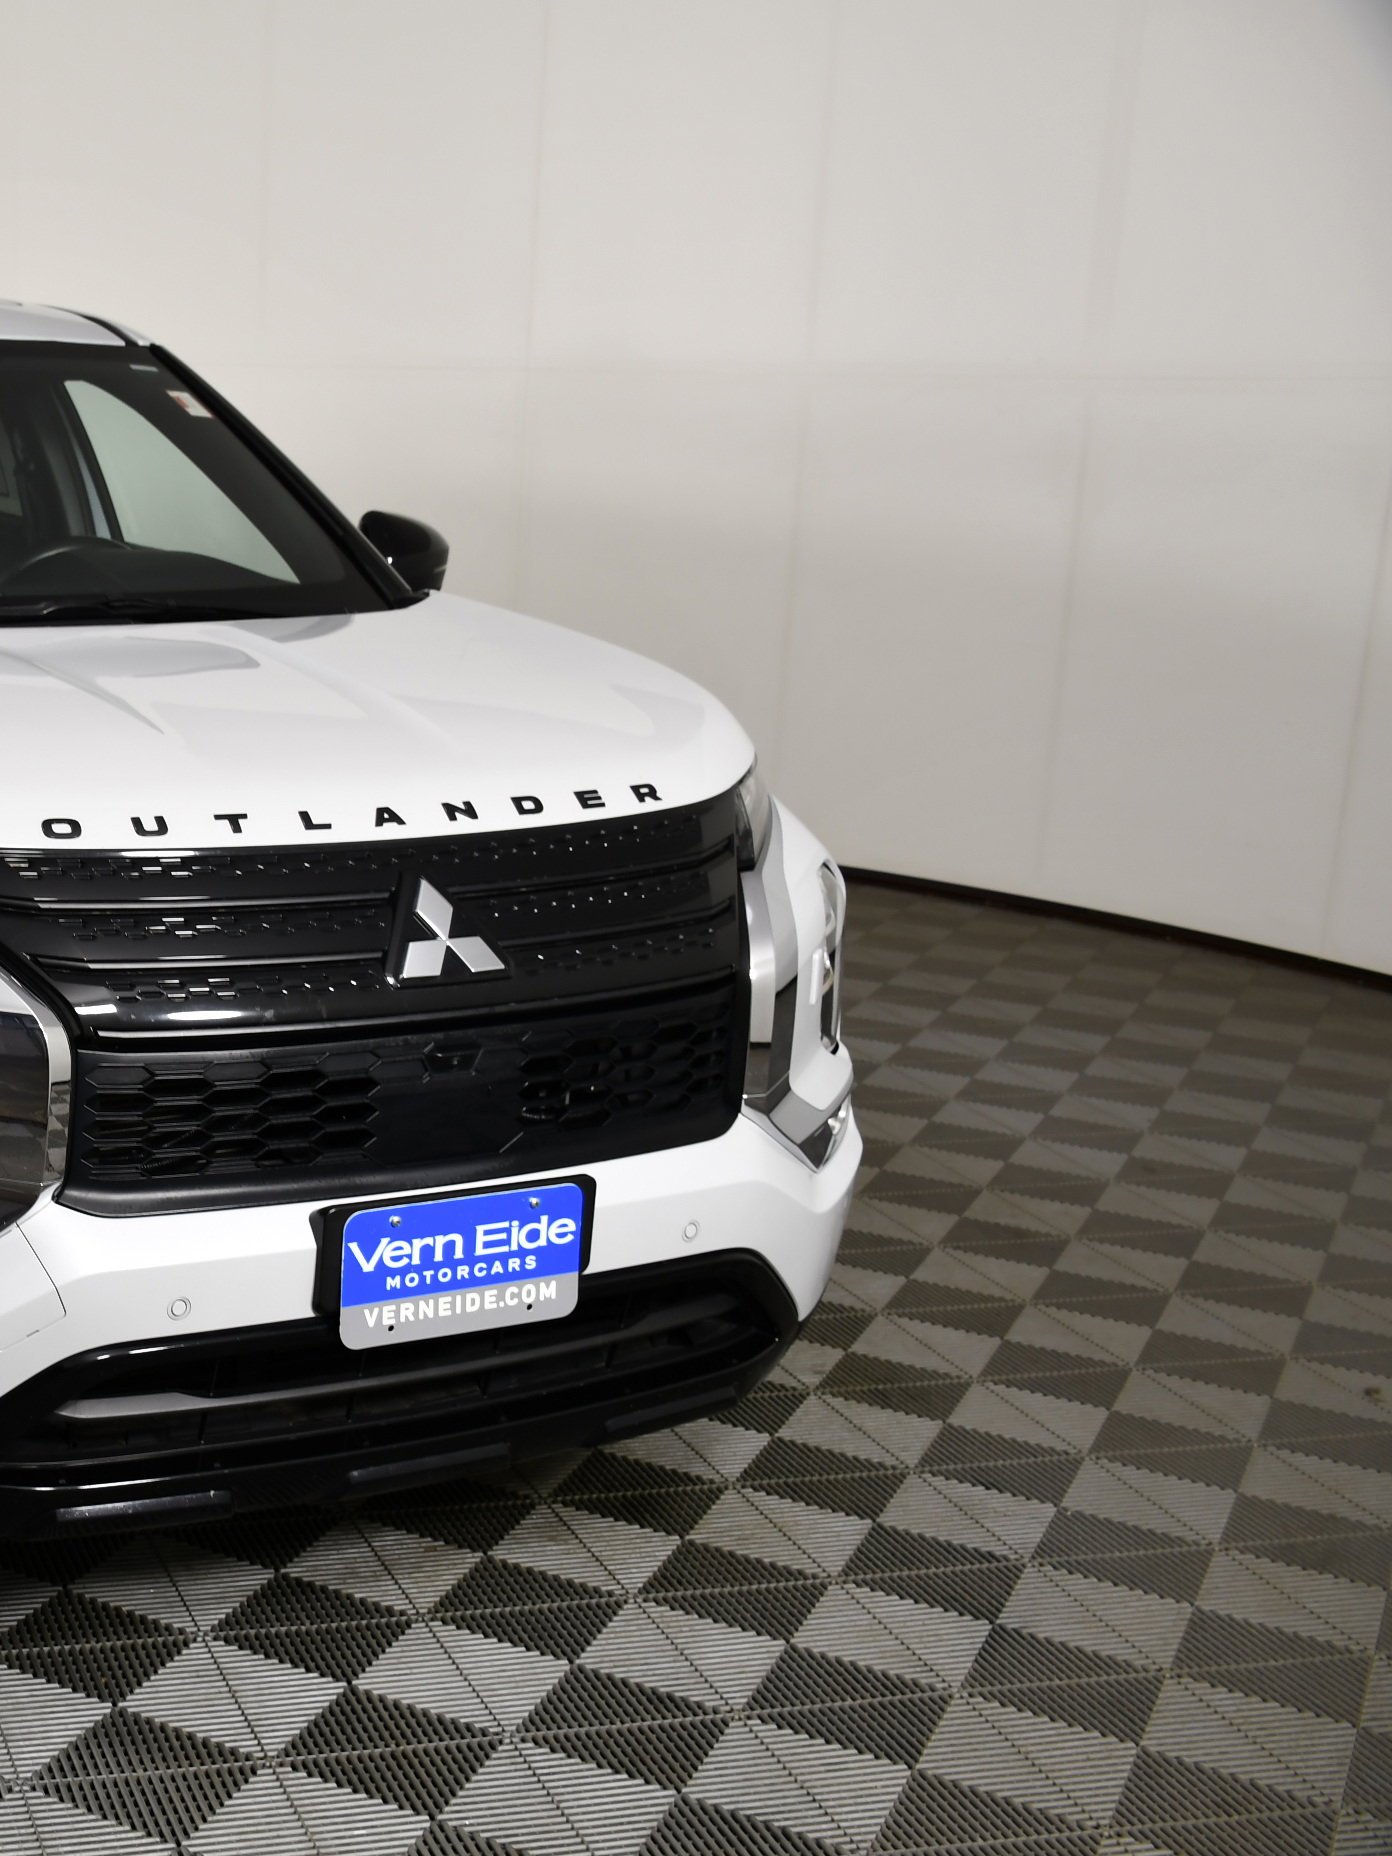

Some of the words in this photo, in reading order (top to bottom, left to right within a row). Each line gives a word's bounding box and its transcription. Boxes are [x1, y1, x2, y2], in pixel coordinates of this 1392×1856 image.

[41, 783, 663, 840] OUTLANDER
[347, 1231, 464, 1273] Vern
[473, 1215, 576, 1257] Eide
[386, 1255, 537, 1291] MOTORCARS
[363, 1280, 557, 1328] VERNEIDE.COM
